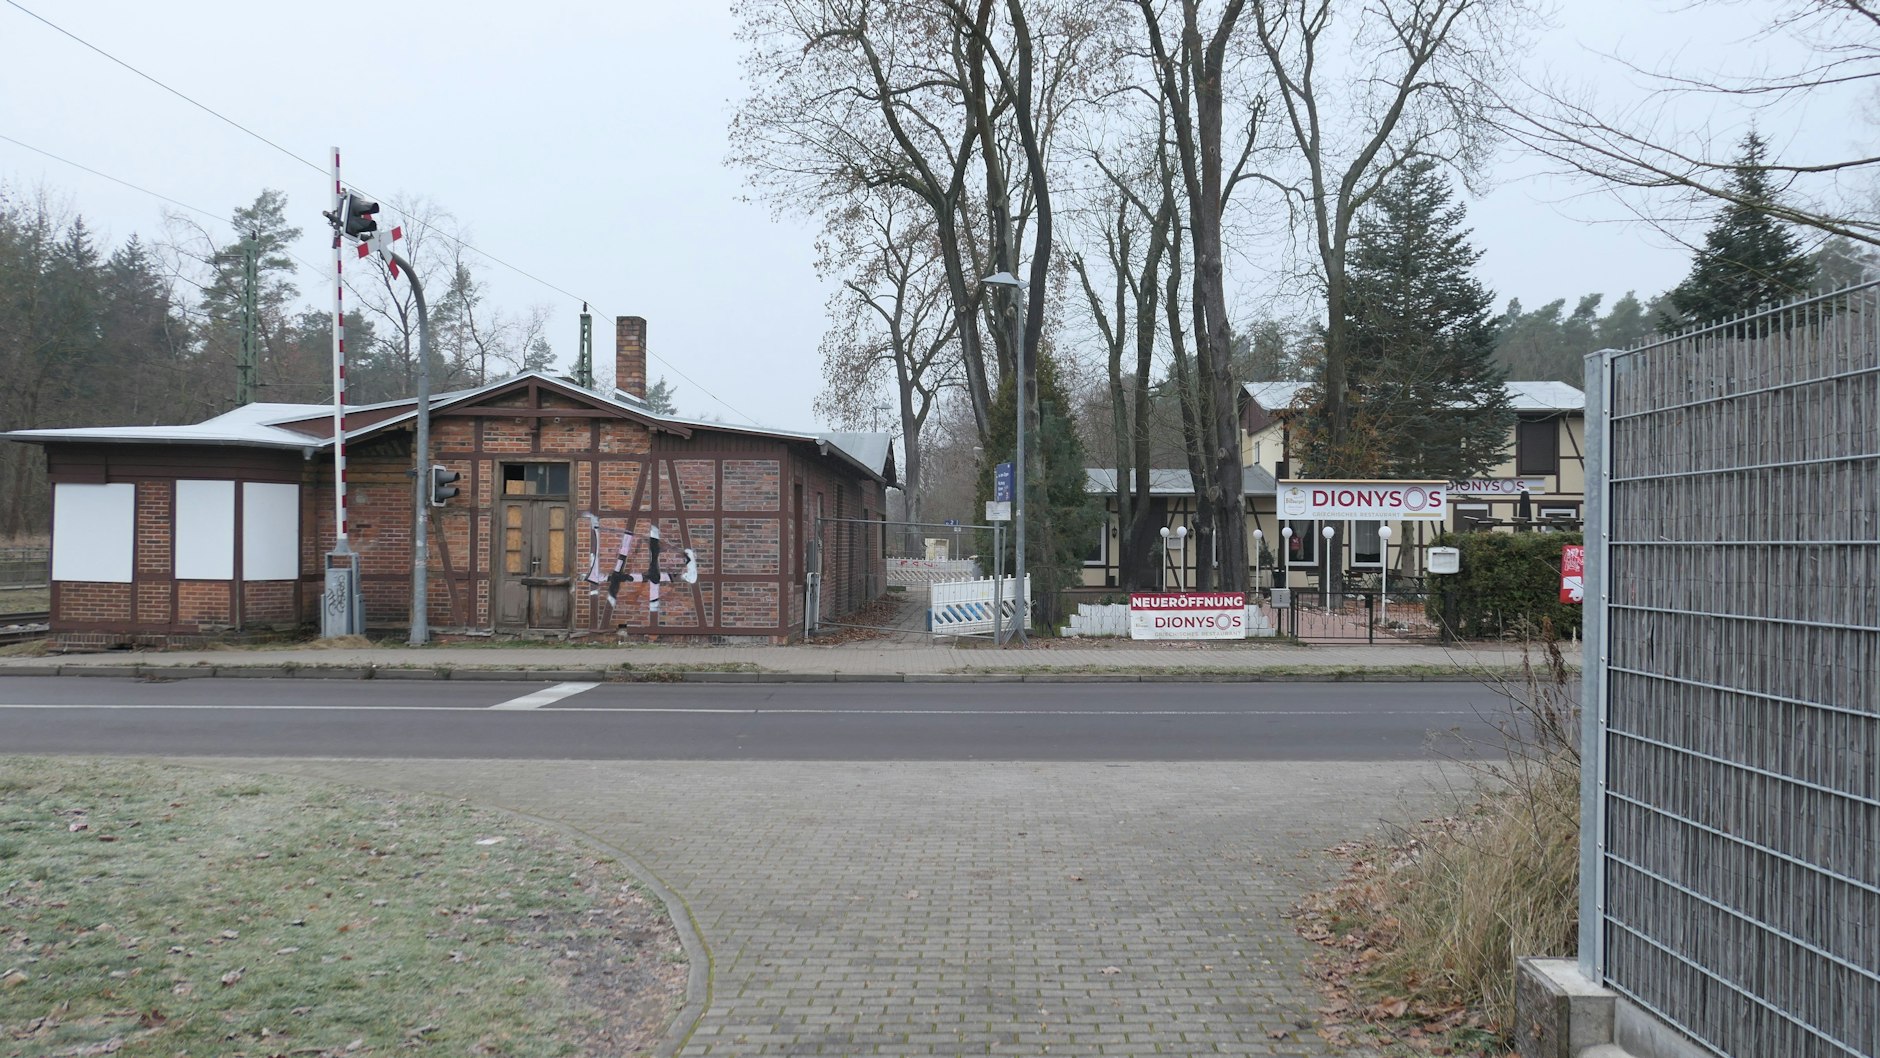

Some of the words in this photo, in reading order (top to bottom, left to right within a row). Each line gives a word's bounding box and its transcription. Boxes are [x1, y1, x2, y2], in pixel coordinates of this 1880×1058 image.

[1446, 479, 1525, 493] DIONYSOS
[1312, 486, 1442, 511] DIONYSOS
[1132, 595, 1243, 608] NEUERÖFFNUNG
[1155, 613, 1241, 630] DIONYSOS
